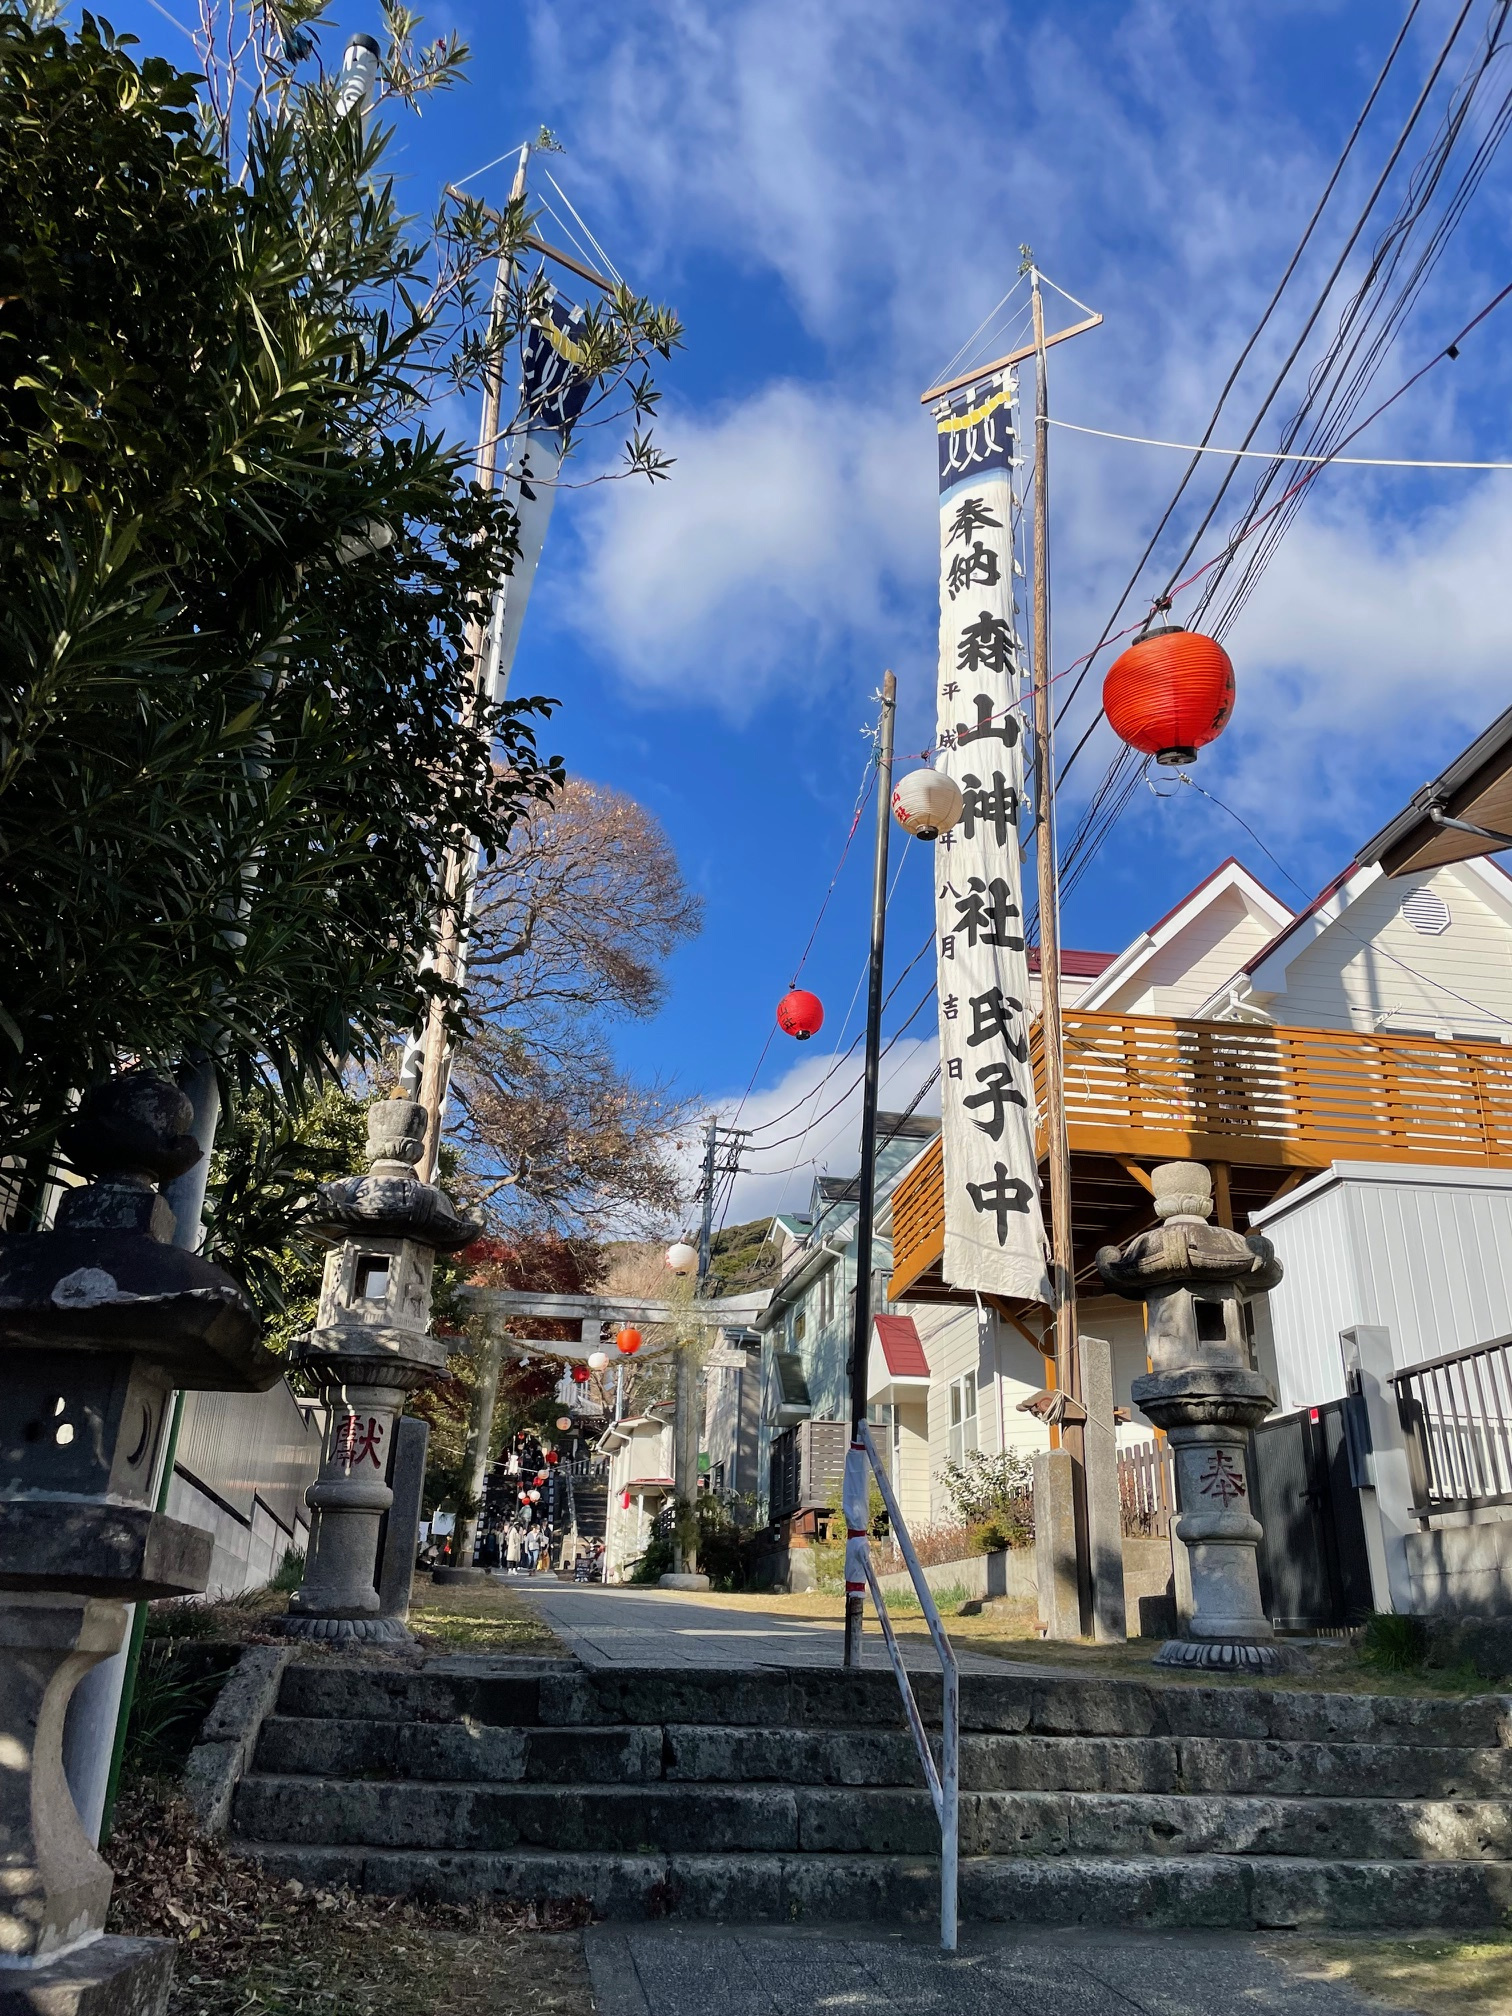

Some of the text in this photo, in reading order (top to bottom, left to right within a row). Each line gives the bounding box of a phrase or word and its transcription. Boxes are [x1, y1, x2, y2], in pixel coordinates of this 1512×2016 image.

[938, 681, 963, 1081] 平成年八月吉日
[1199, 1449, 1246, 1508] 奉
